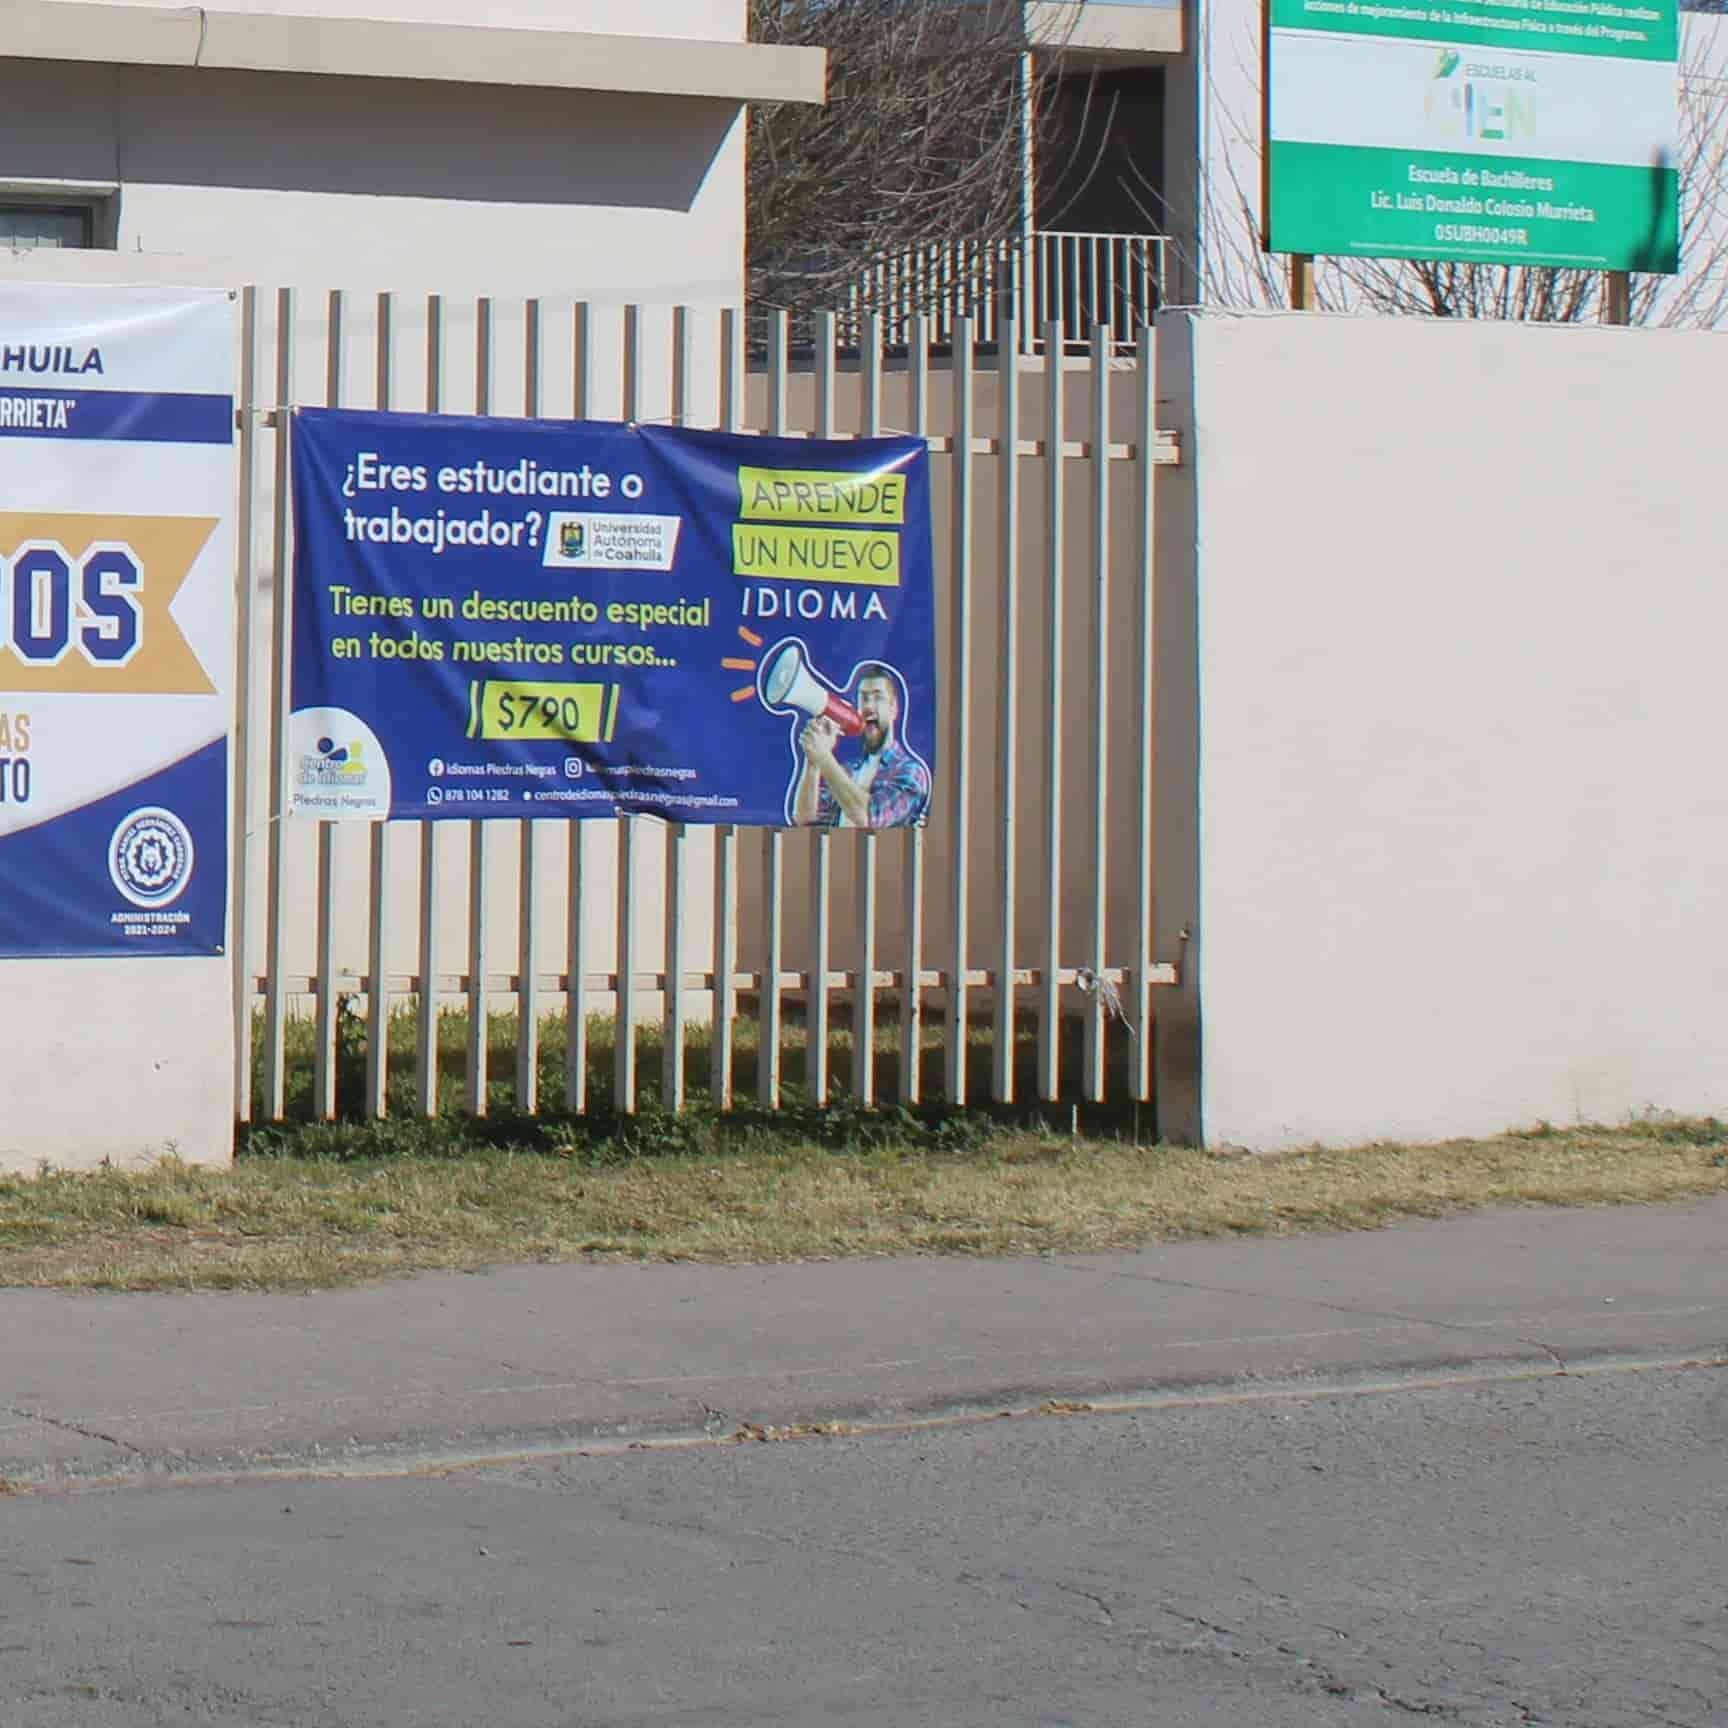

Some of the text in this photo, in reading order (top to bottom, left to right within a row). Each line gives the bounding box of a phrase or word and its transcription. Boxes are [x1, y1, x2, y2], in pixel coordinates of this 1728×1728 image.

[1464, 63, 1523, 81] ESCUELAS
[1407, 164, 1554, 192] Escuela de Bachilleres
[1371, 191, 1596, 224] Lic. Luis Donaldo Colosio Murrieta
[341, 451, 644, 499] ¿Eres estudiante o
[751, 480, 898, 515] APRENDE
[343, 506, 543, 554] trabajador?
[592, 521, 662, 535] Universidad
[604, 547, 662, 562] Coahuila
[738, 535, 894, 571] UN NUEVO
[328, 584, 712, 631] Tienes un descuento especial
[741, 586, 889, 621] IDIOMA
[330, 631, 678, 668] en todos nuestros cursos...
[497, 690, 580, 732] $790
[292, 792, 338, 807] Piedras
[445, 789, 465, 802] 878
[466, 789, 484, 802] 104
